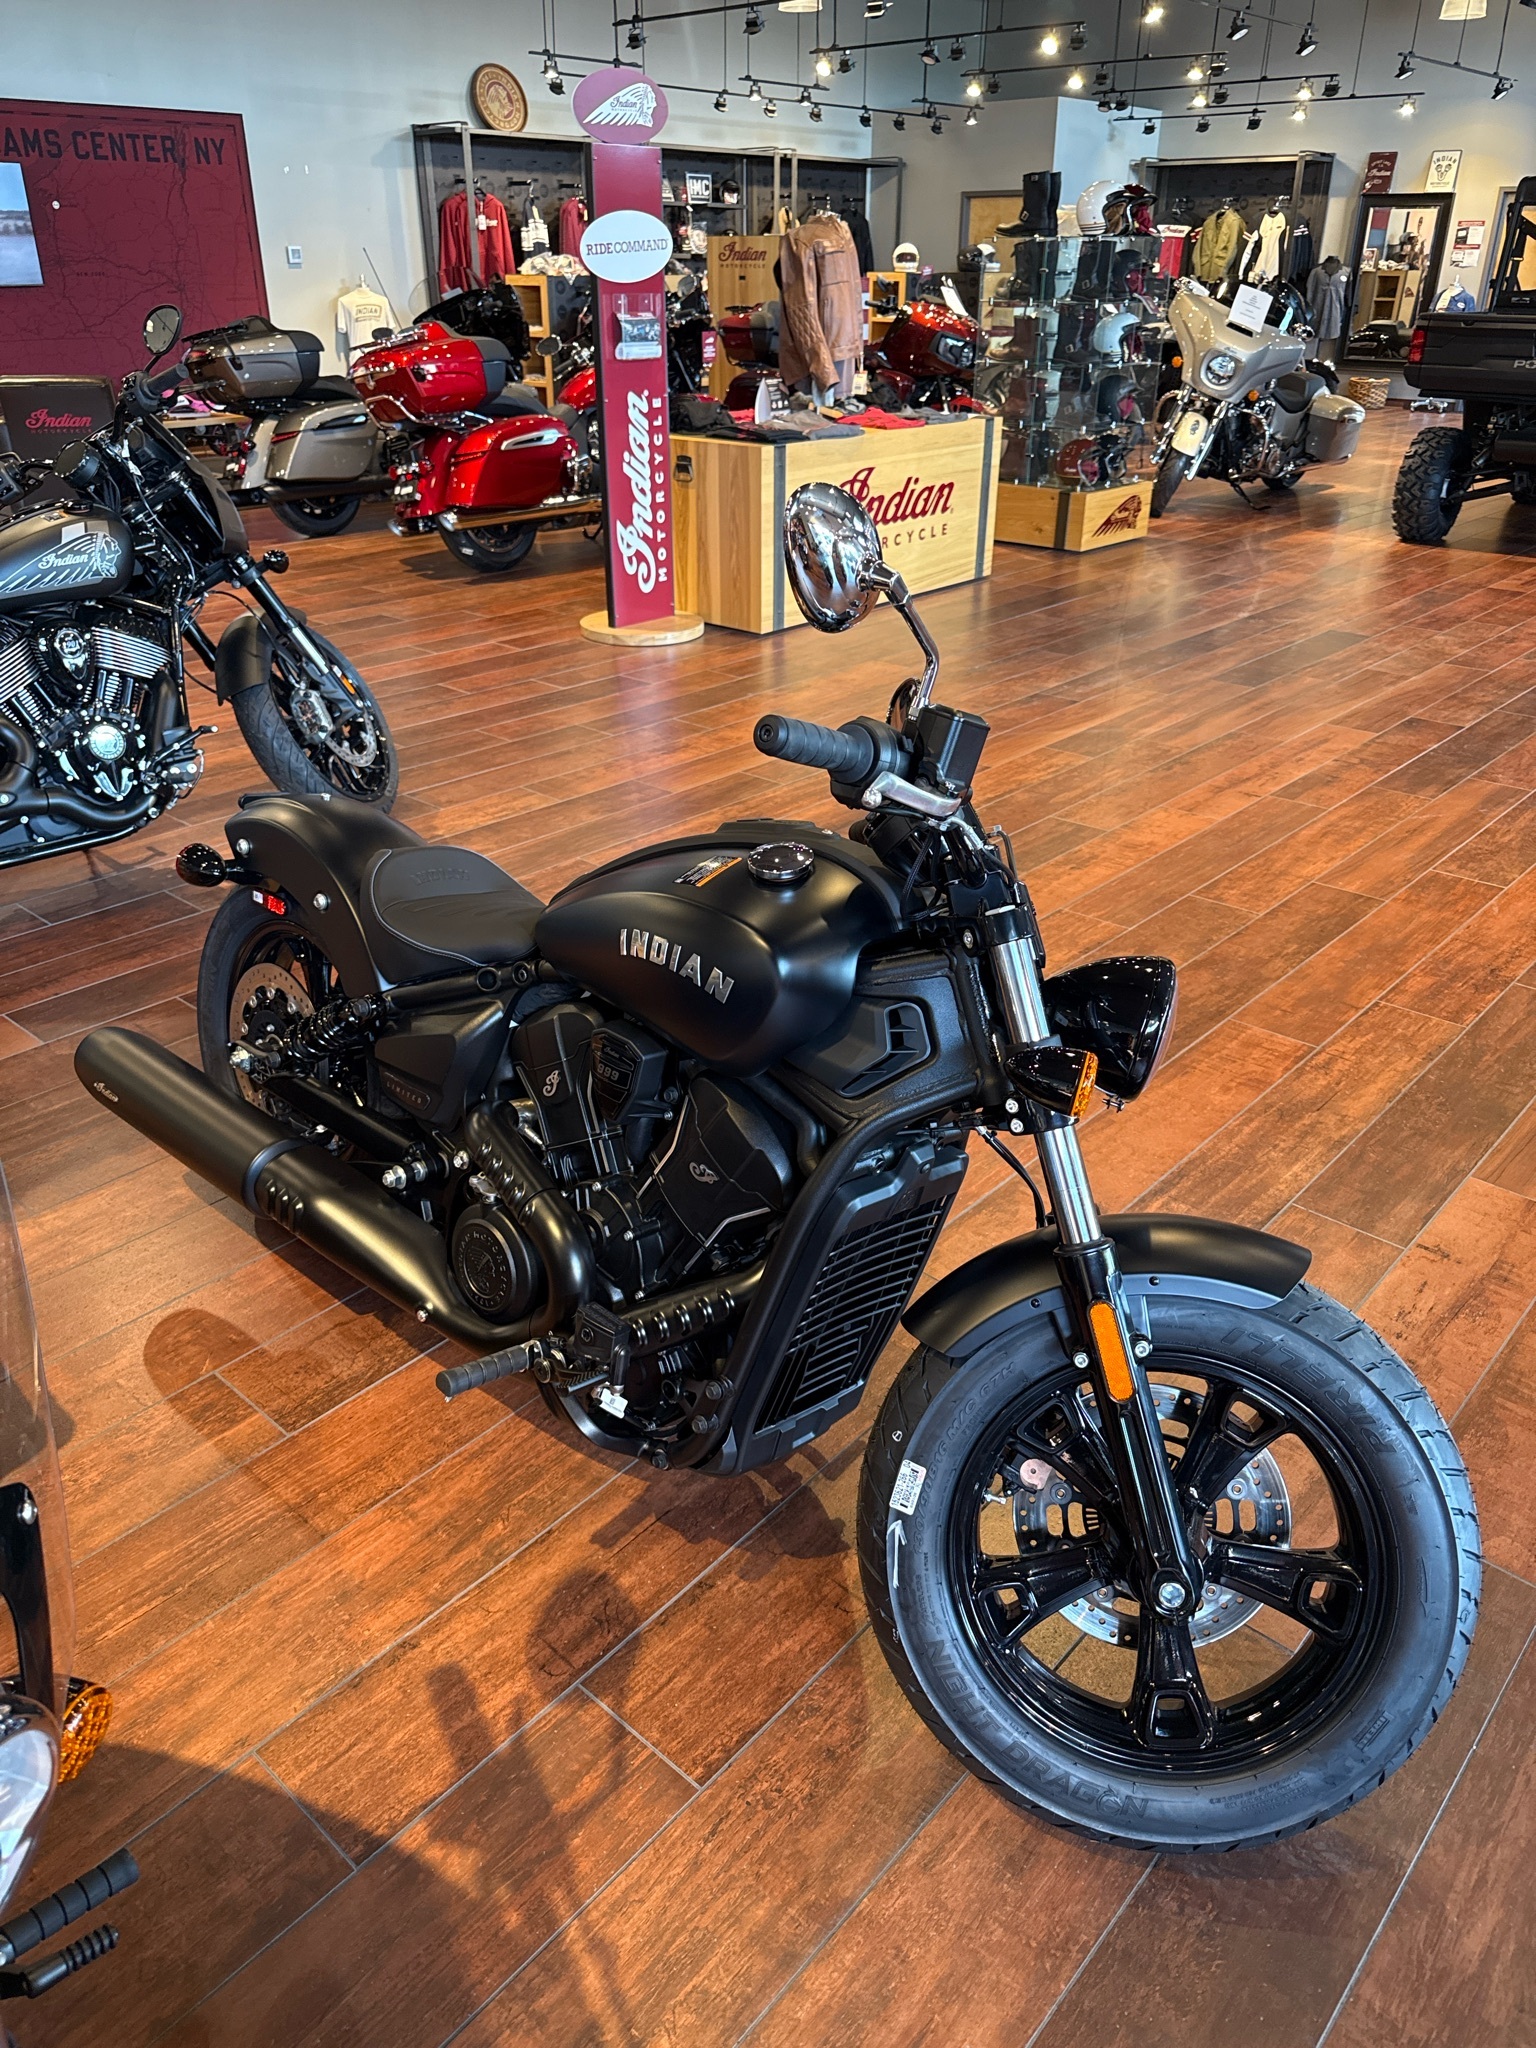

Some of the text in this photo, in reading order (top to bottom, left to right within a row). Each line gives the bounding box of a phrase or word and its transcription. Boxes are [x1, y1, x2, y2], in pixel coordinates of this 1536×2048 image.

[610, 96, 637, 109] Indian
[194, 137, 225, 165] NY
[1433, 156, 1457, 165] INDIAN
[719, 242, 767, 262] Indian
[356, 308, 378, 316] INDIAN
[25, 408, 92, 428] Indian
[616, 390, 656, 594] Indian
[652, 397, 668, 582] MOTORCYCLE
[38, 552, 89, 570] Indian
[620, 928, 735, 1004] INDIAN
[598, 1063, 620, 1081] 999
[1220, 1327, 1398, 1455] PIRELLI
[924, 1639, 1003, 1732] NIGHT
[1000, 1739, 1149, 1819] DRAGON
